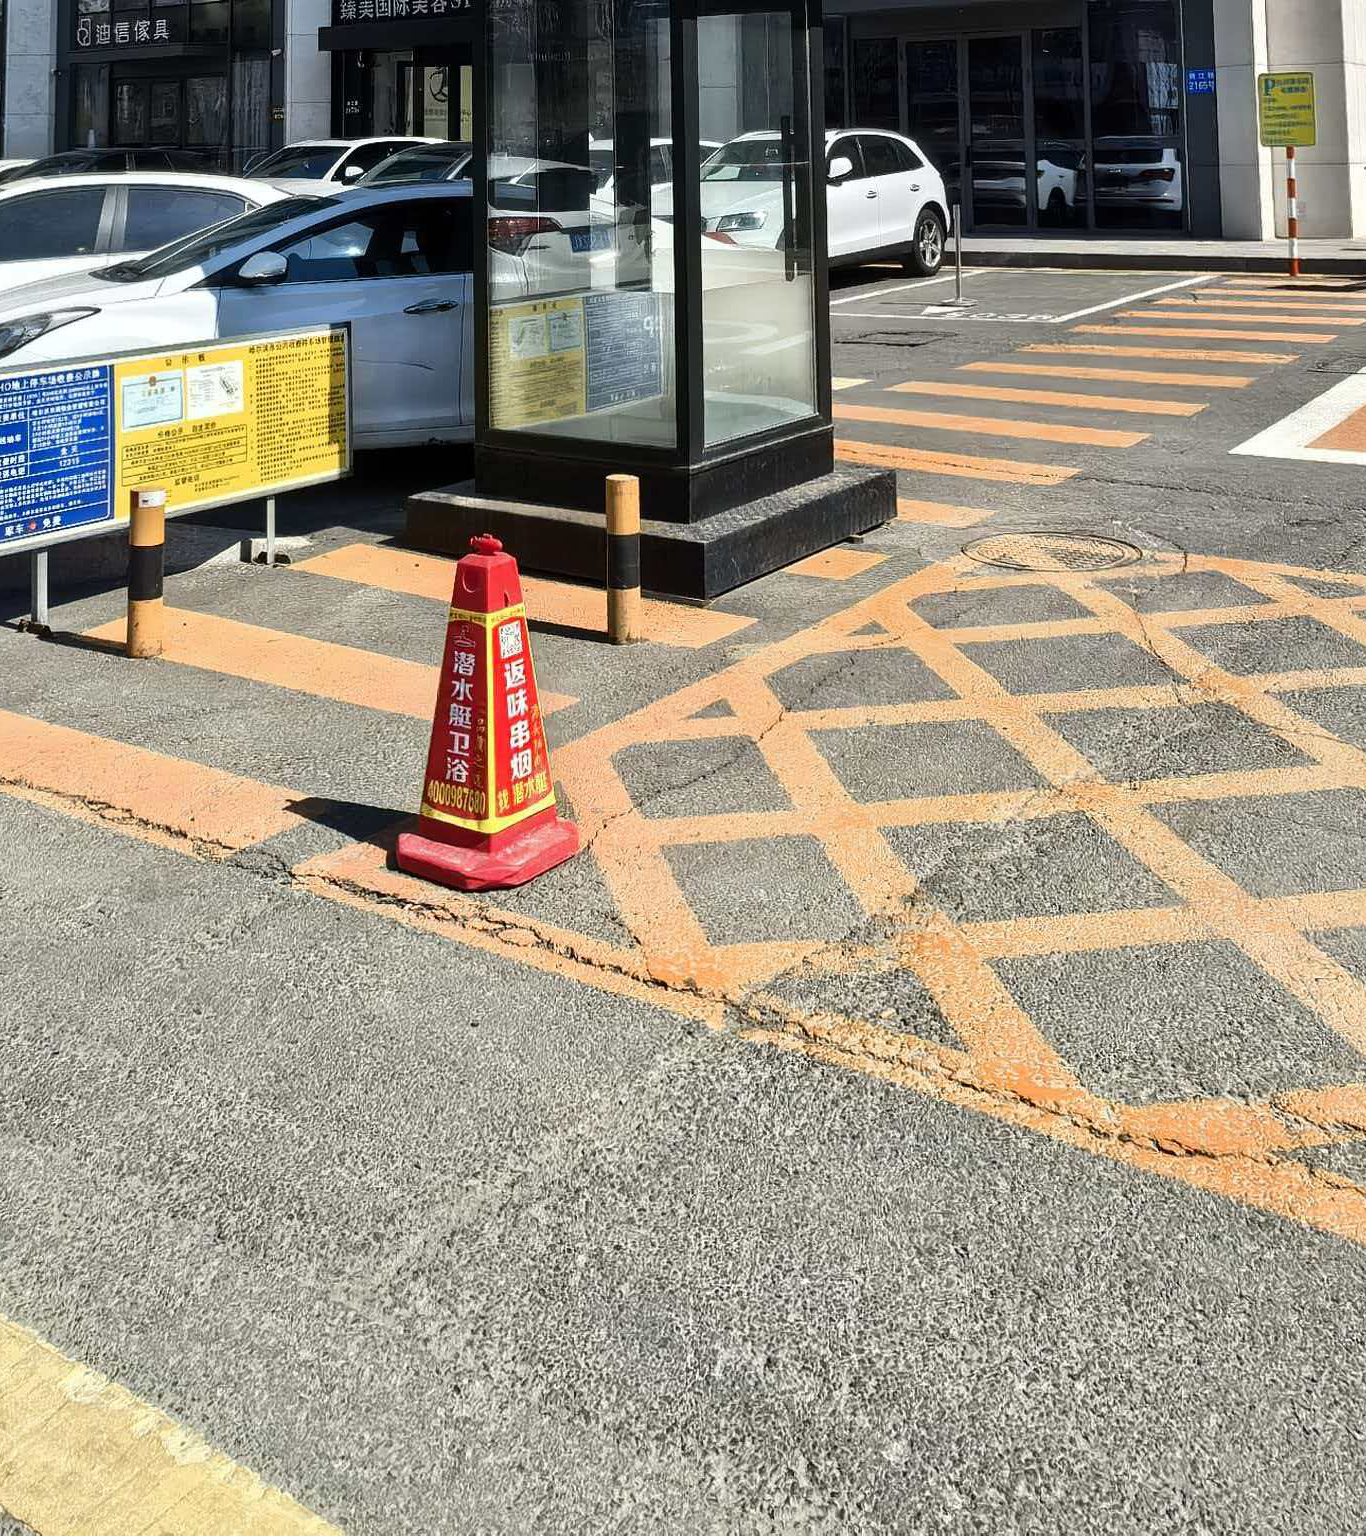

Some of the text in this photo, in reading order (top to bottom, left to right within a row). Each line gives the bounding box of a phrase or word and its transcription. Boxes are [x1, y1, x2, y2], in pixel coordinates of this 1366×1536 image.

[96, 19, 171, 45] 迪信傢具
[445, 649, 476, 783] 潜水艇卫浴
[503, 660, 532, 782] 返味串烟
[427, 779, 486, 815] 4000987680
